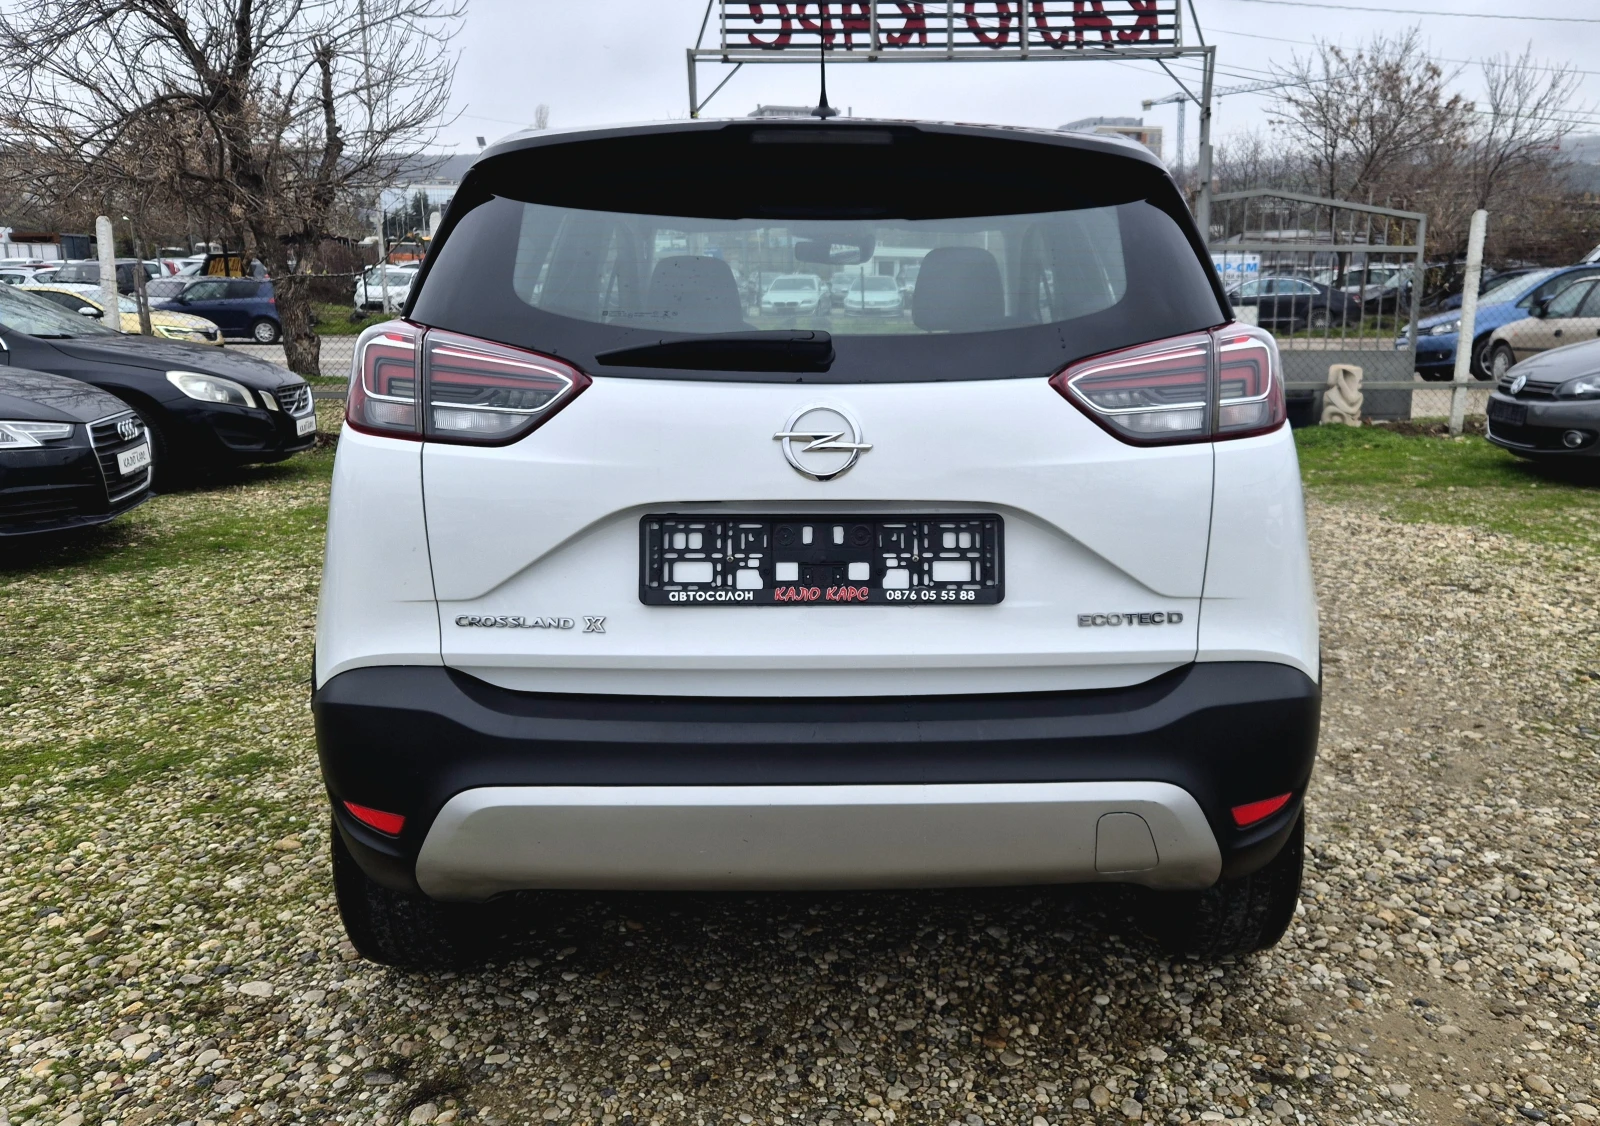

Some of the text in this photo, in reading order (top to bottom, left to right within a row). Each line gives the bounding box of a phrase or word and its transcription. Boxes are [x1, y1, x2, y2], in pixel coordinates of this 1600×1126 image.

[669, 586, 976, 602] автосалон КАЛО КАРС 0876 05 55 88
[455, 614, 606, 633] CROSSLAND X
[1077, 611, 1165, 628] ECOTEC
